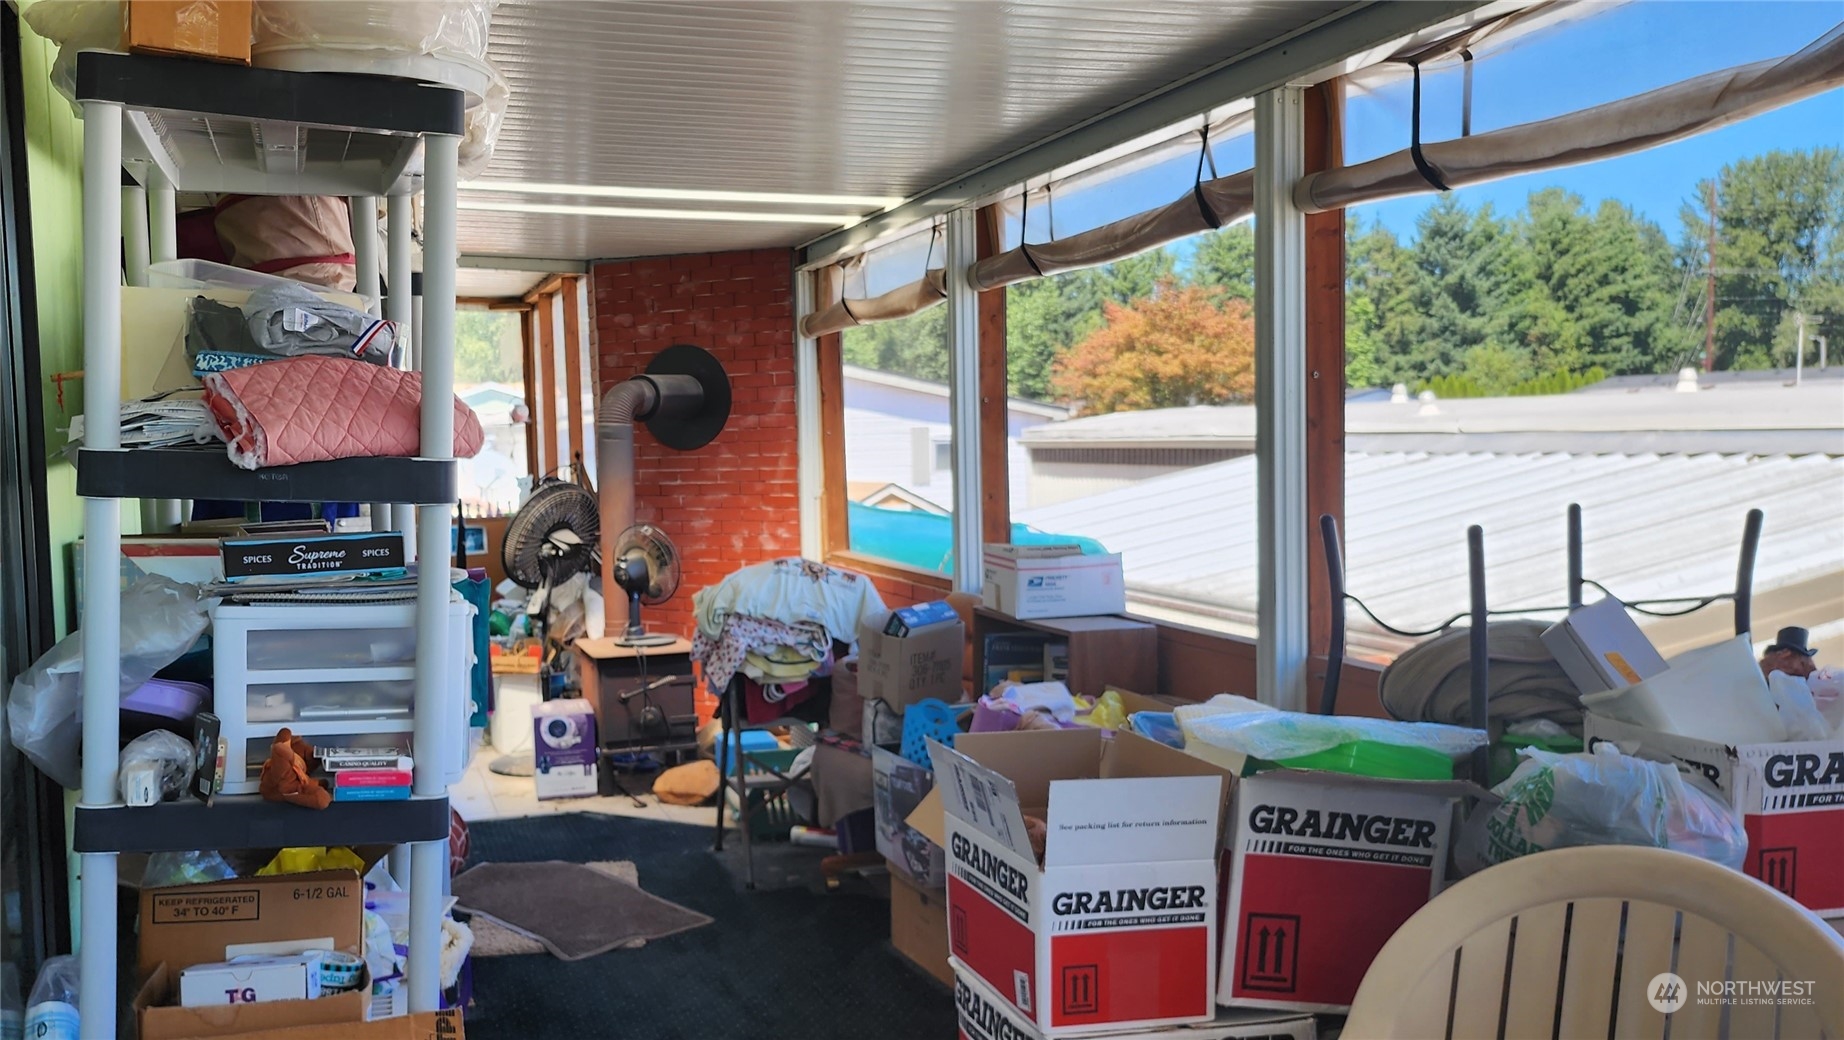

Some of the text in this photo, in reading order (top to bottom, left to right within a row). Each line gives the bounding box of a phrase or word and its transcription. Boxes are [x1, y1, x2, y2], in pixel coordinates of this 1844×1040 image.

[288, 545, 346, 564] Supreme
[362, 548, 389, 557] SPICES
[243, 555, 272, 564] SPICES
[296, 561, 342, 570] TRADITION
[1075, 823, 1106, 831] packing
[1108, 820, 1120, 828] list
[1122, 820, 1133, 828] for
[1135, 819, 1160, 827] return
[1162, 818, 1207, 827] information
[1249, 804, 1436, 848] GRAINGER
[1289, 845, 1305, 853] FOR
[1308, 846, 1323, 854] THE
[1326, 848, 1349, 856] ONES
[1352, 851, 1371, 859] WHO
[1373, 853, 1389, 861] GET
[952, 831, 1029, 904] GRAINGER
[294, 887, 349, 900] 6-1/2 GAL
[159, 896, 255, 906] KEEP REFRIGERATED
[1052, 885, 1206, 916] GRAINGER
[193, 907, 209, 916] TO
[231, 905, 239, 915] F
